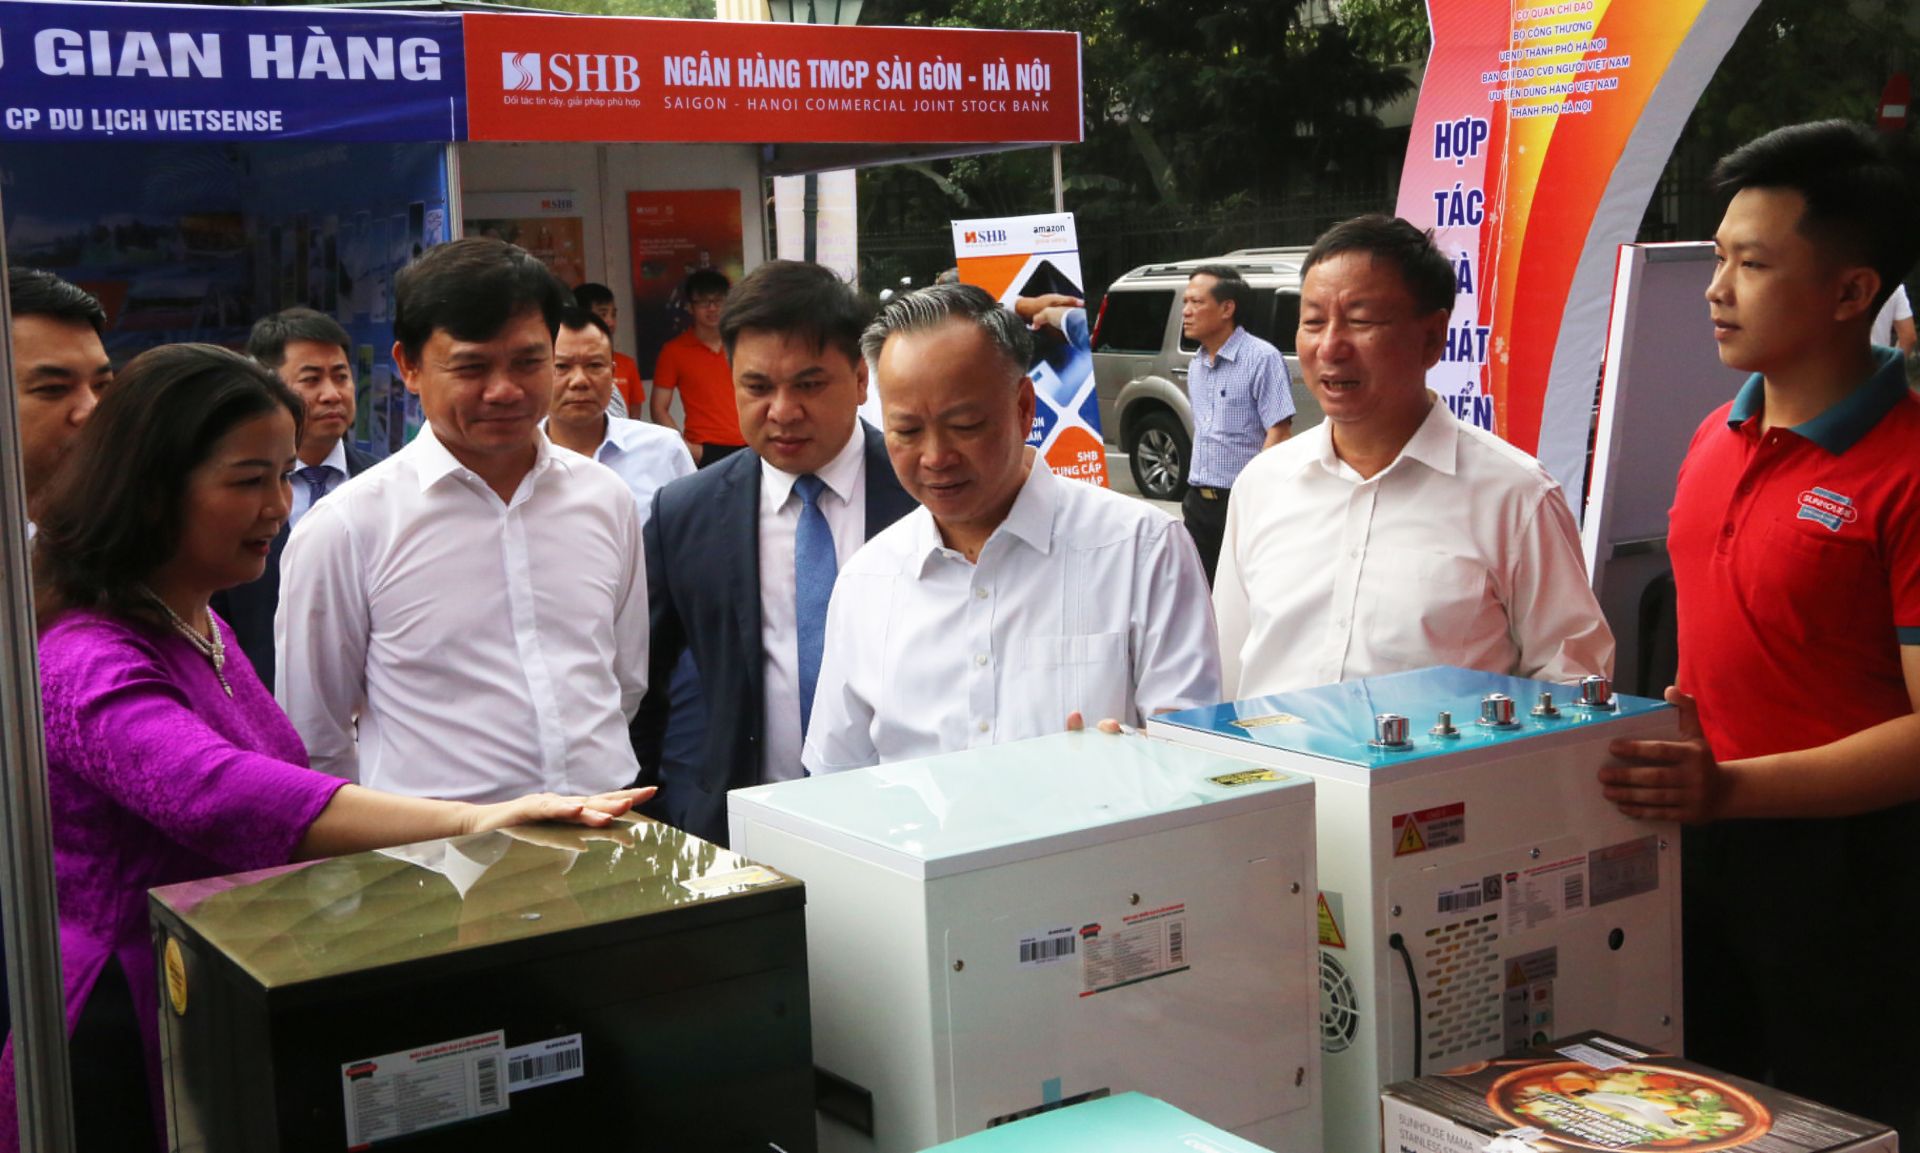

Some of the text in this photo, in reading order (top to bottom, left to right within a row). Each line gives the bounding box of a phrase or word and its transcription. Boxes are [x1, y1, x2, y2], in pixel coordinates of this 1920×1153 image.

[1531, 7, 1555, 18] QUAN
[1574, 1, 1593, 13] ĐẠO
[1527, 26, 1552, 38] CÔNG
[1555, 21, 1592, 34] THƯƠNG
[34, 28, 222, 78] GIAN
[248, 26, 442, 81] HÀNG
[1590, 39, 1606, 51] NỘI
[549, 53, 641, 92] SHB
[663, 50, 731, 87] NGÂN
[738, 52, 800, 88] HÀNG
[807, 59, 869, 90] TMCP
[876, 55, 911, 90] SÀI
[918, 55, 962, 91] GÒN
[983, 57, 1010, 91] HÀ
[1016, 58, 1050, 97] NỘI
[1482, 72, 1499, 83] BAN
[1537, 65, 1553, 76] CVĐ
[1587, 60, 1606, 72] VIỆT
[1609, 57, 1629, 68] NAM
[1575, 80, 1595, 93] VIỆT
[1597, 78, 1617, 89] NAM
[503, 95, 519, 105] Đối
[521, 95, 533, 105] tác
[567, 96, 582, 108] giải
[584, 97, 605, 108] pháp
[607, 97, 623, 108] phù
[625, 97, 641, 109] hợp
[664, 96, 726, 109] SAIGON
[747, 98, 798, 110] HANOI
[805, 98, 906, 112] COMMERCIAL
[913, 100, 954, 112] JOINT
[962, 100, 1007, 112] STOCK
[1013, 100, 1050, 112] BANK
[1561, 102, 1573, 113] HÀ
[1575, 101, 1591, 113] NỘI
[5, 107, 283, 135] CP DU LỊCH VIETSENSE
[1435, 118, 1487, 165] HỢP
[1434, 183, 1483, 227] TÁC
[977, 230, 1007, 243] SHB
[1033, 224, 1066, 234] amazon
[1440, 320, 1490, 363] HÁT
[1077, 451, 1098, 462] SHB
